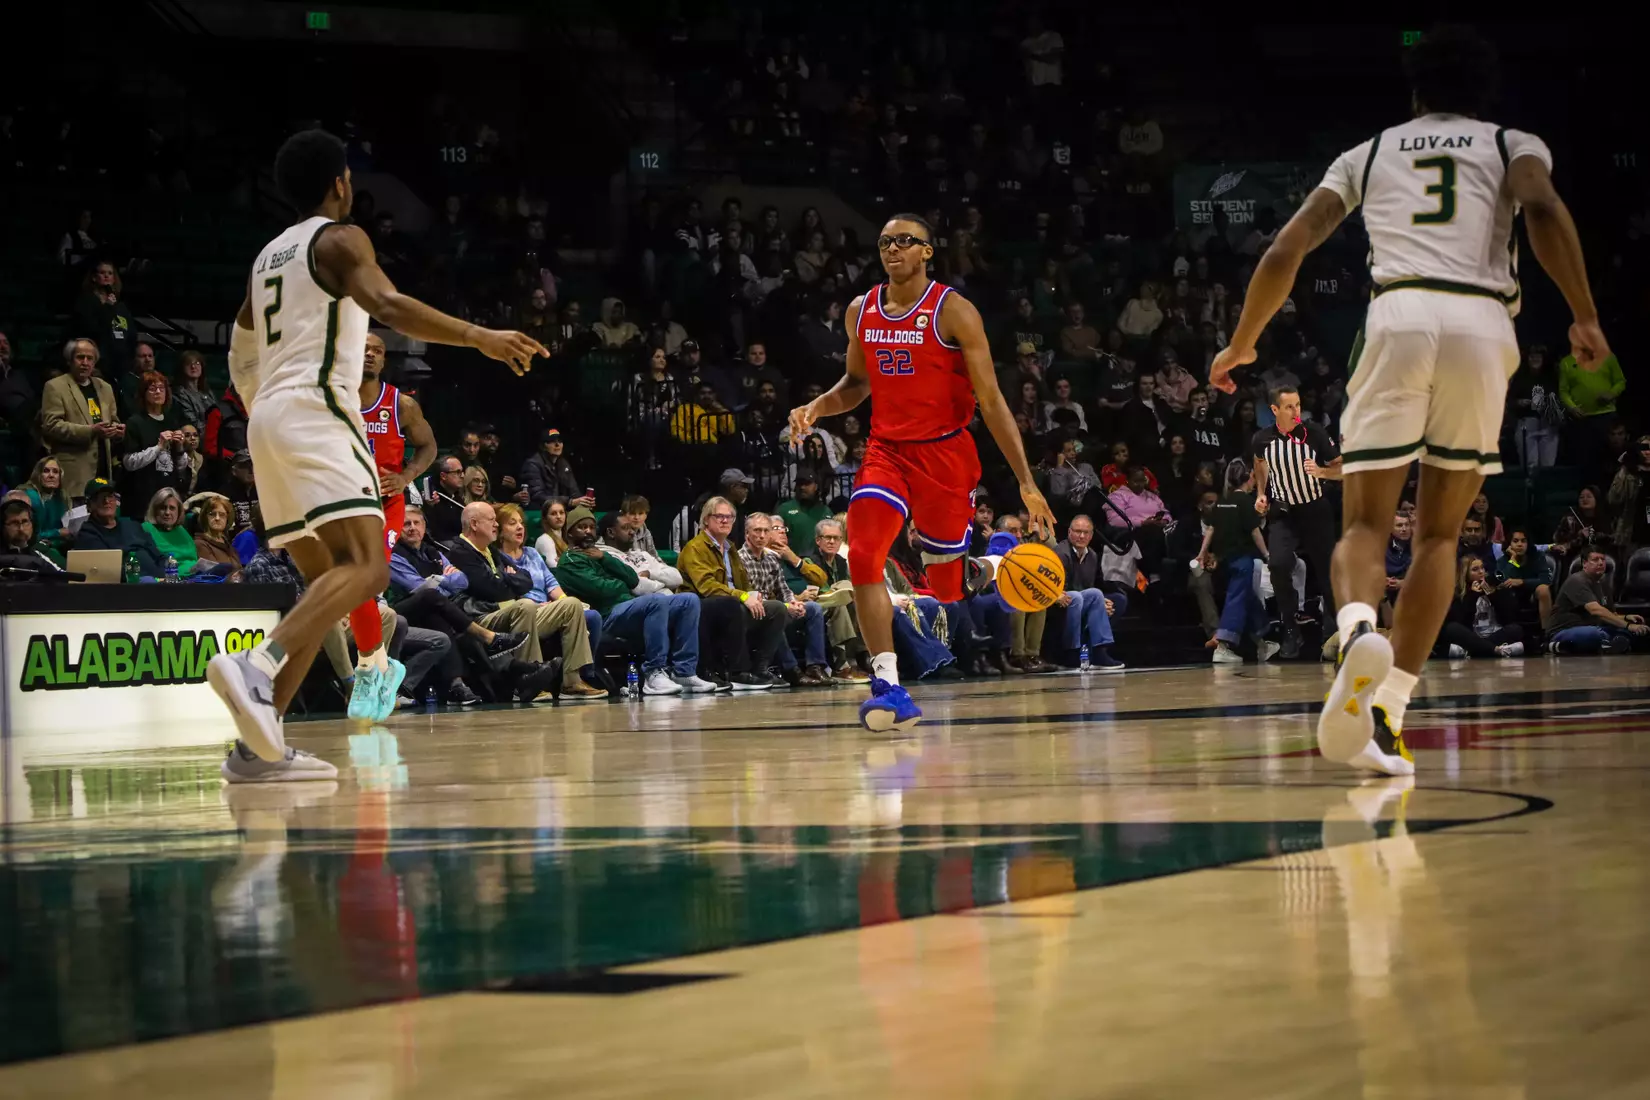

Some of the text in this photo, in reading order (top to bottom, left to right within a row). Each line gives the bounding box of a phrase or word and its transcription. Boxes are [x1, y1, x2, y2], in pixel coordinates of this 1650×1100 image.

[1399, 136, 1473, 151] LOVAN
[439, 146, 467, 163] 113
[640, 152, 659, 168] 112
[1612, 152, 1637, 168] 111
[1412, 155, 1456, 225] 3
[1192, 212, 1255, 224] SEION
[263, 275, 284, 345] 2
[864, 329, 924, 345] BULLDOGS
[875, 348, 916, 376] 22
[1037, 563, 1063, 588] NCAA
[1020, 575, 1054, 606] Wilson
[21, 630, 220, 691] ALABAMA
